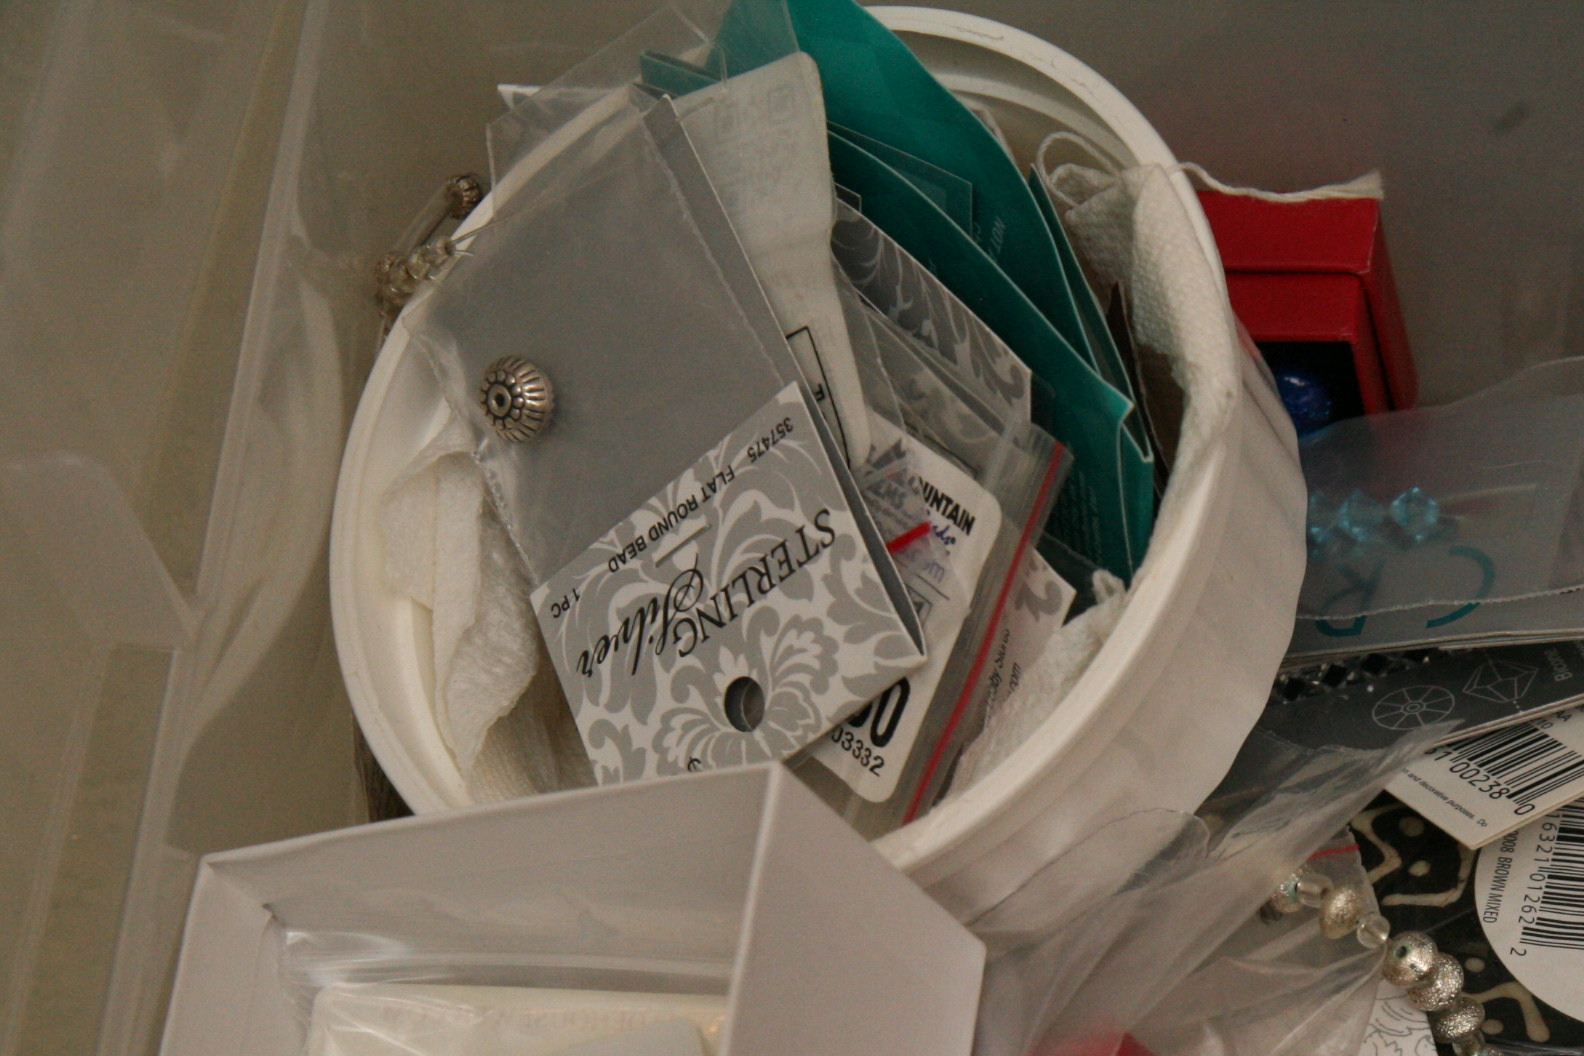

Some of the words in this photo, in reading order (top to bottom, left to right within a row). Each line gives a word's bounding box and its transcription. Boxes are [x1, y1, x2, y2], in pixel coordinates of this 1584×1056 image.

[746, 416, 793, 463] 357475
[698, 463, 734, 502] FLAT
[647, 493, 698, 543] ROUND
[607, 536, 647, 575] BEAD
[570, 586, 582, 600] 1
[670, 508, 837, 659] STERLING
[546, 594, 575, 619] PC
[576, 552, 699, 682] Silver
[1448, 760, 1510, 799] 00238
[1513, 802, 1535, 816] 0
[1489, 856, 1512, 891] BROWN
[1482, 892, 1503, 923] MIXED
[1518, 872, 1541, 925] 01262
[1509, 947, 1526, 957] 2
